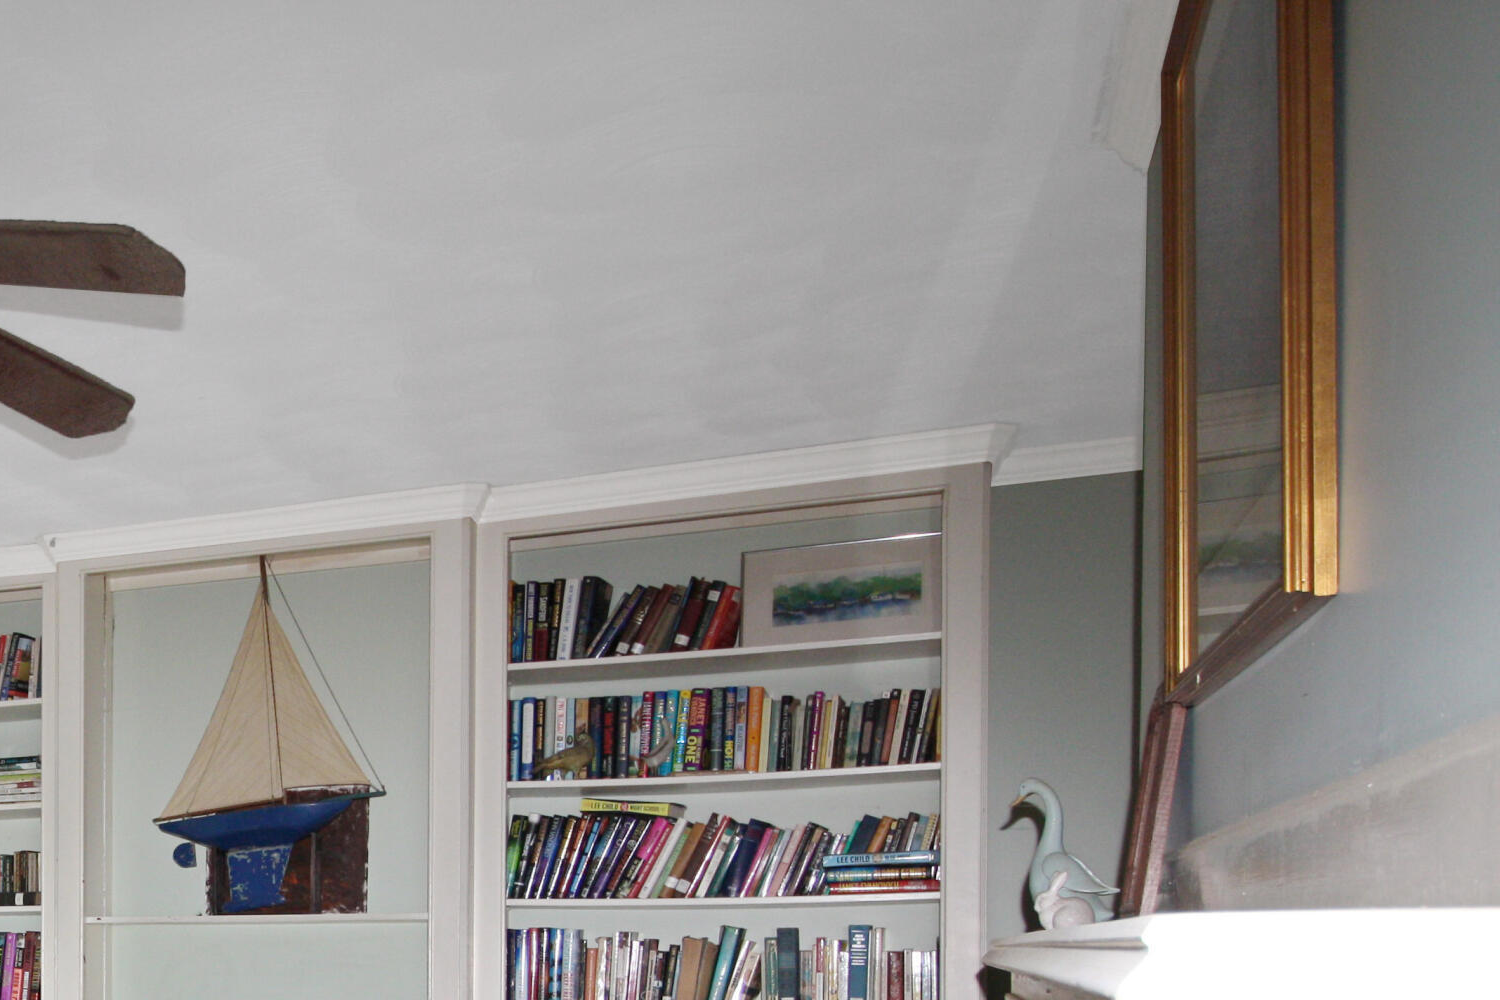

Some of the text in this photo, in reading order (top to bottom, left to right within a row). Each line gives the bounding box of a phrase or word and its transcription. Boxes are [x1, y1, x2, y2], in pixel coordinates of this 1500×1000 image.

[685, 735, 698, 763] ONE
[837, 855, 871, 864] LEE CHILD
